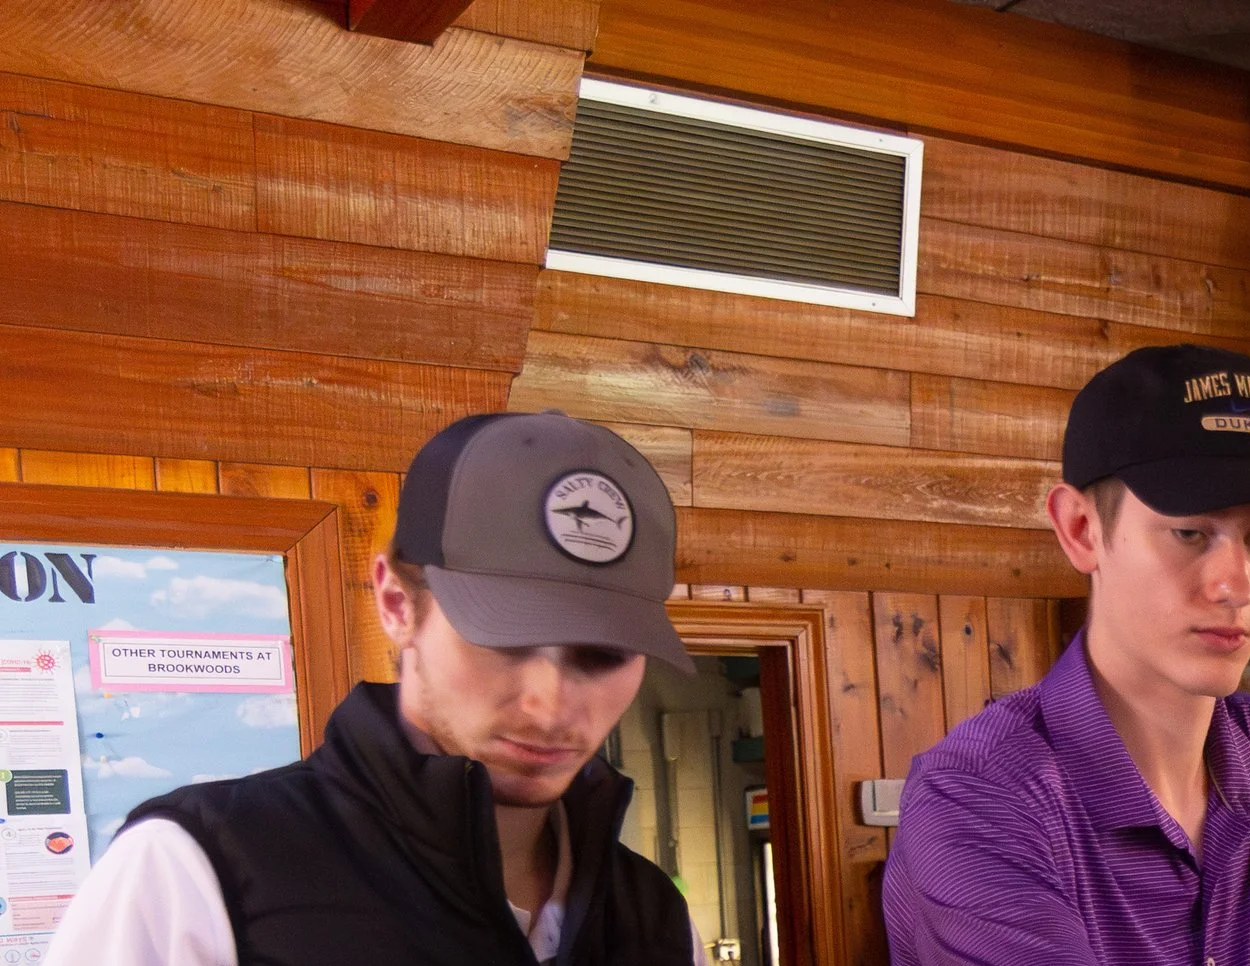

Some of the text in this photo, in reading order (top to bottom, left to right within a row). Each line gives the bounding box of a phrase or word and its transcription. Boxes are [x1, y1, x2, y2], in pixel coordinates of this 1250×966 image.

[1184, 371, 1232, 404] JAMES
[0, 550, 97, 604] ON
[112, 648, 273, 661] OTHER TOURNAMENTS AT
[148, 663, 241, 674] BROOKWOODS
